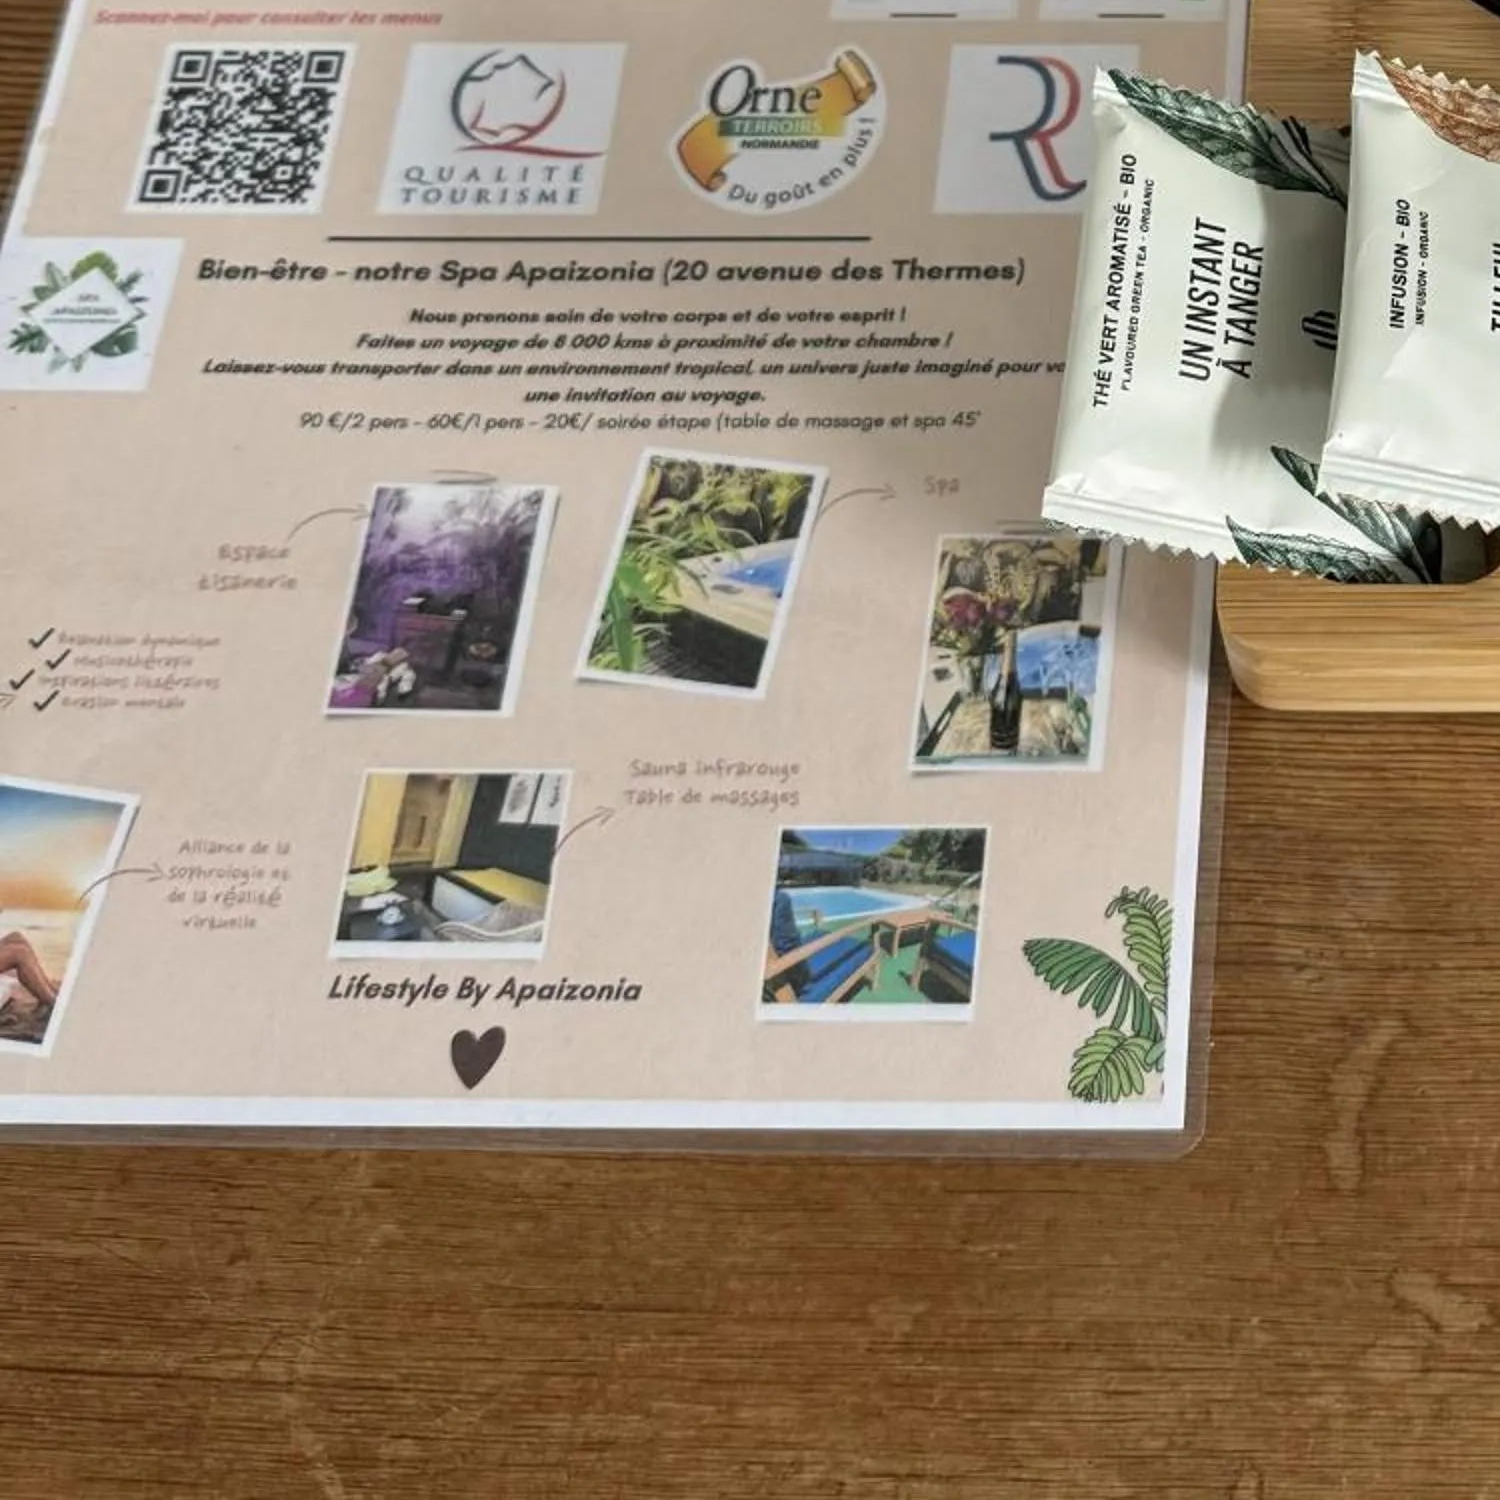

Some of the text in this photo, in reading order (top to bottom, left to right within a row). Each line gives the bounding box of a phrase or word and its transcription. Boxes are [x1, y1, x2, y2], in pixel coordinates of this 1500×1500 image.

[710, 65, 823, 117] Orne
[741, 139, 820, 150] NORMANDIE
[404, 163, 584, 185] QUALITÉ
[727, 129, 873, 209] Du goût en plus
[401, 187, 582, 204] TOURISME
[197, 258, 1025, 287] Bien-être notre Spa Apaizonia (20 avenue des Thermes)
[1389, 198, 1411, 329] INFUSION BIO
[1093, 154, 1137, 408] THÉ VERT AROMATISÉ BIO
[1121, 179, 1155, 391] FLAVOURED GREEN TEA ORGANIC
[1224, 240, 1264, 346] TANGER
[1179, 216, 1226, 381] UN INSTANT
[1415, 269, 1427, 325] INFUSION
[409, 308, 895, 327] Nous prenons soin de votre corps et de votre esprit
[356, 334, 415, 349] Faites
[420, 338, 444, 349] un
[449, 337, 518, 353] voyage
[523, 334, 548, 349] de
[569, 334, 610, 349] 000
[657, 333, 670, 349] à
[673, 333, 768, 352] proximité
[772, 334, 796, 349] de
[801, 336, 850, 349] votre
[855, 334, 940, 349] chambre
[202, 358, 1041, 379] Laissez-vous transporter dans un environnement un univers juste imaginé pour
[524, 388, 766, 407] une invitation au voyage.
[299, 413, 323, 429] 90
[598, 412, 651, 429] soirée
[657, 412, 711, 432] étape
[717, 411, 770, 431] (table
[775, 412, 798, 428] de
[805, 415, 885, 432] massage
[890, 413, 909, 428] et
[914, 415, 946, 432] spa
[923, 476, 961, 496] Spa
[680, 787, 702, 804] de
[328, 973, 643, 1008] Lifestyle By Apaizonia
